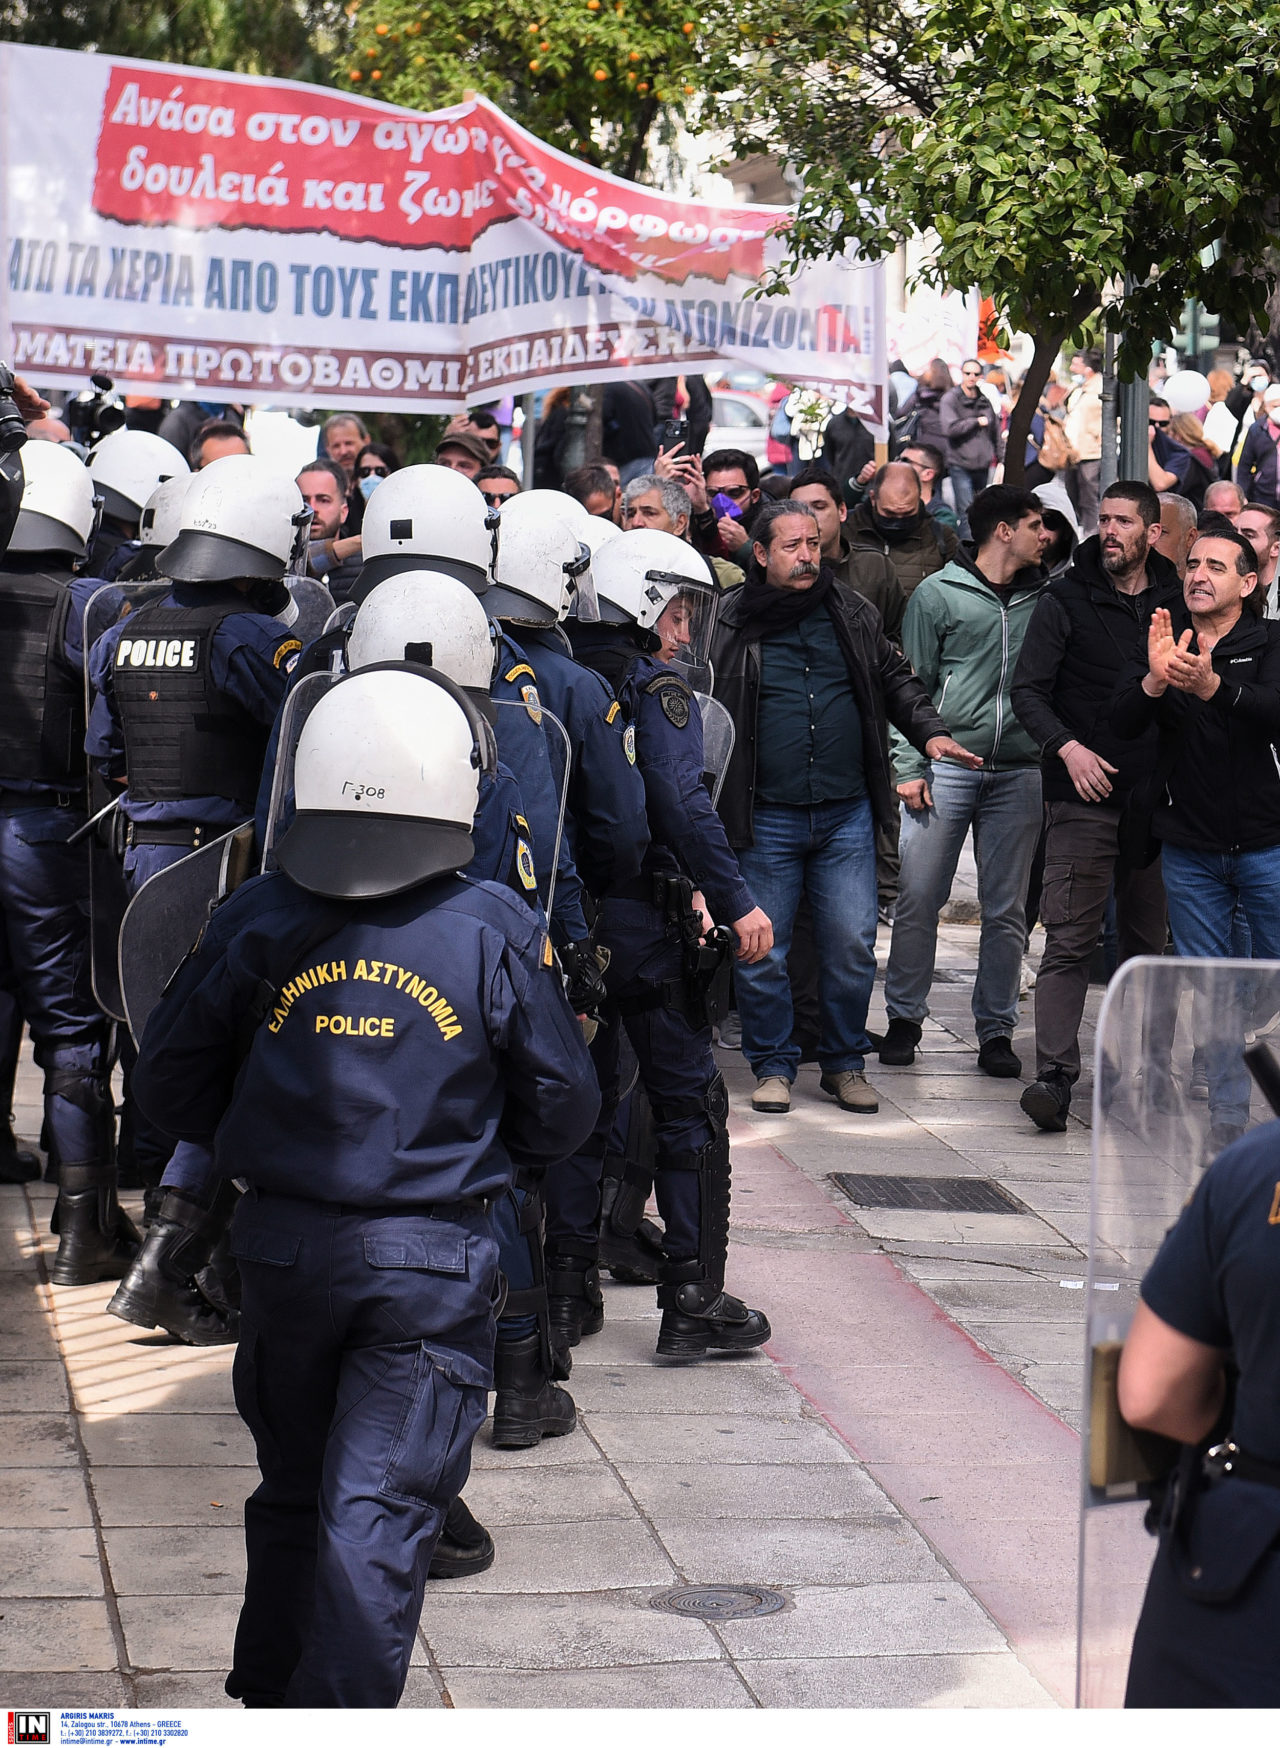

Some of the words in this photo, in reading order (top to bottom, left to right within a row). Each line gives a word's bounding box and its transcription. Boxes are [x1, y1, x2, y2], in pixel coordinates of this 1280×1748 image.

[112, 82, 235, 138] Ανάσα
[246, 112, 360, 148] στον
[120, 146, 290, 207] δουλειά
[302, 178, 386, 213] και
[9, 238, 57, 292] ΑΤΩ
[64, 242, 99, 296] ΤΑ
[104, 246, 195, 307] ΧΕΡΙΑ
[204, 256, 278, 314] ΑΠΟ
[291, 264, 379, 321] ΤΟΥΣ
[15, 330, 155, 375] ΜΑΤΕΙΑ
[165, 342, 475, 393] ΠΡΩΤΟΒΑΘΜΙ
[117, 640, 196, 668] POLICE
[268, 960, 347, 1034] ΕΛΛΗΝΙΚΗ
[353, 959, 463, 1042] ΑΣΤΥΝΟΜΙΑ
[315, 1015, 395, 1037] POLICE
